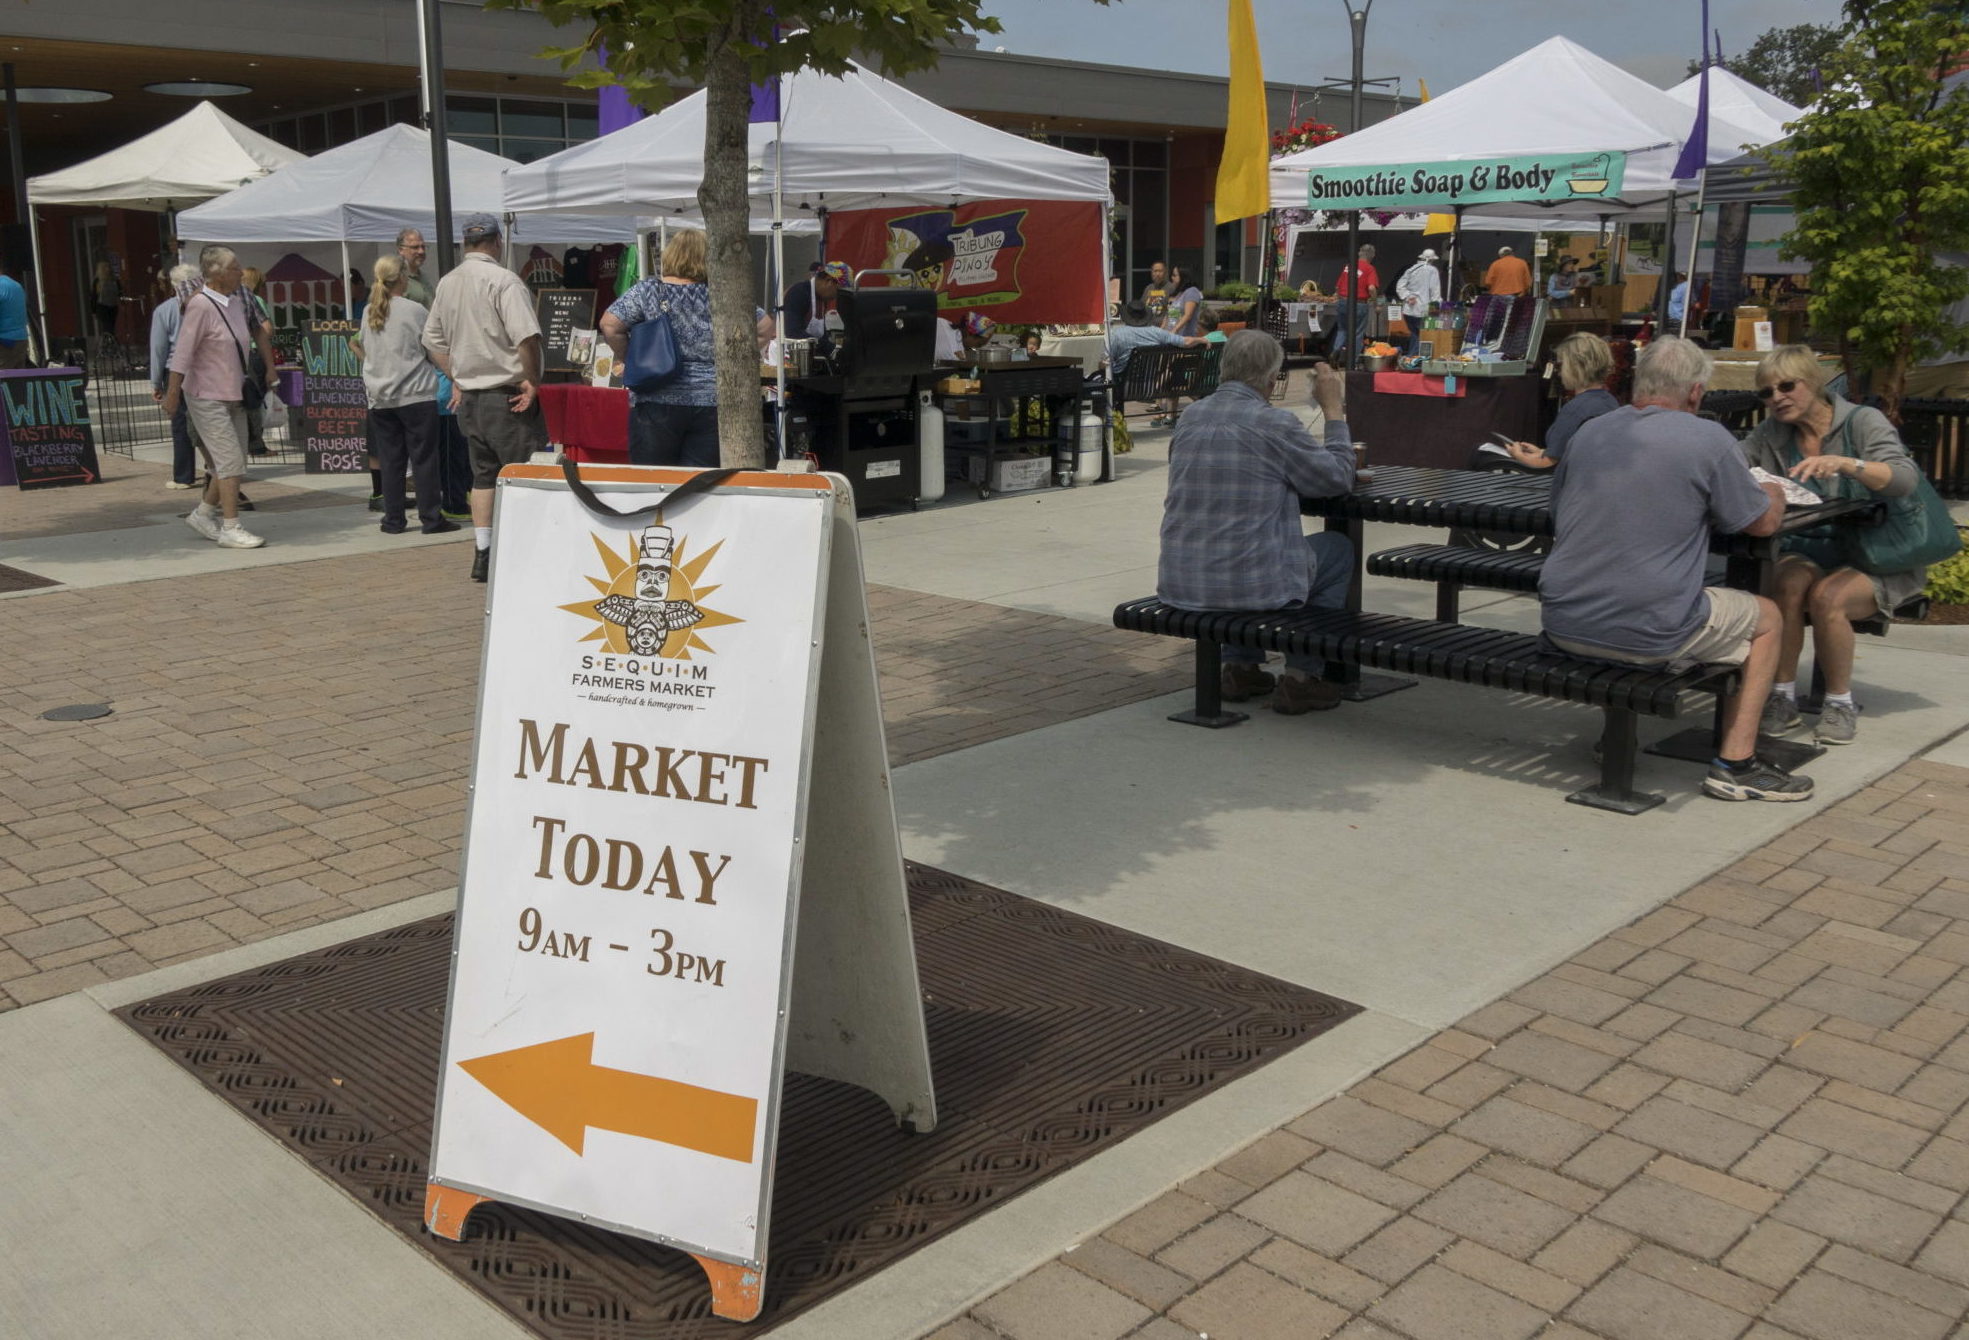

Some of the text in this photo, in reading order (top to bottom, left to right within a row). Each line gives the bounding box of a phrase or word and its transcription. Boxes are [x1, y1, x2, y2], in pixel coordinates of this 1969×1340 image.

[1311, 171, 1405, 199] Smoothie
[1410, 169, 1463, 198] Soap
[1469, 166, 1489, 192] &
[1495, 162, 1555, 194] Body
[952, 234, 1002, 252] TRIBUNG
[311, 321, 360, 332] LOCAL
[302, 335, 363, 376] WIN
[305, 376, 366, 391] BLACKBER
[1, 379, 91, 426] WINE
[311, 391, 367, 405] LAVENDER
[9, 425, 86, 441] TASTING
[318, 421, 359, 434] BEET
[14, 443, 84, 458] BLACKBERRY
[26, 455, 80, 467] LAVENDER
[572, 673, 716, 699] FARMERS MARKET
[588, 692, 637, 707] handcrafted
[647, 699, 694, 711] homegrown
[514, 718, 769, 810] MARKET
[532, 815, 732, 905] TODAY
[518, 907, 592, 962] 9AM
[647, 928, 726, 987] 3PM
